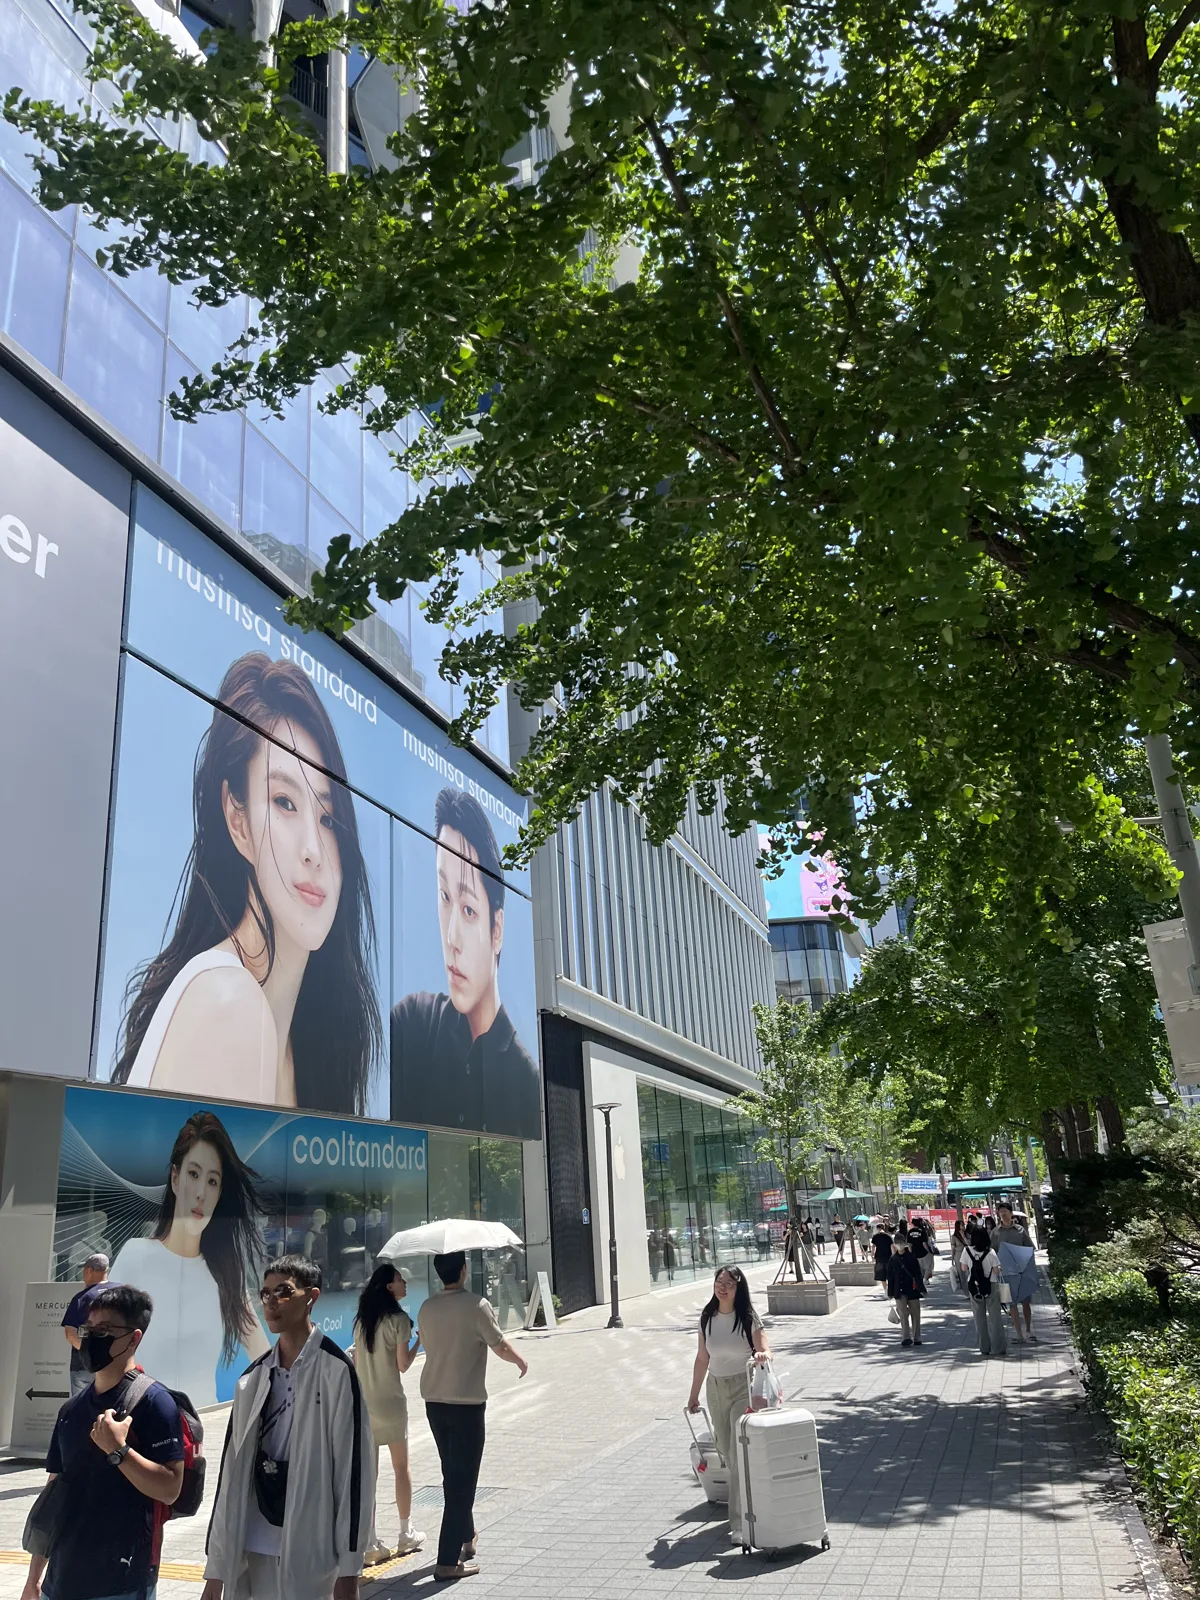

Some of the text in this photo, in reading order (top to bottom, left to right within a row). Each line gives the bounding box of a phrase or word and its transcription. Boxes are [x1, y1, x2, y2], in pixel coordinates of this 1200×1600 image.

[156, 537, 377, 725] musinsa standard
[403, 726, 464, 790] musinsa
[293, 1130, 426, 1171] cooltandard
[35, 1302, 71, 1310] MERCUR
[323, 1315, 343, 1332] Cool
